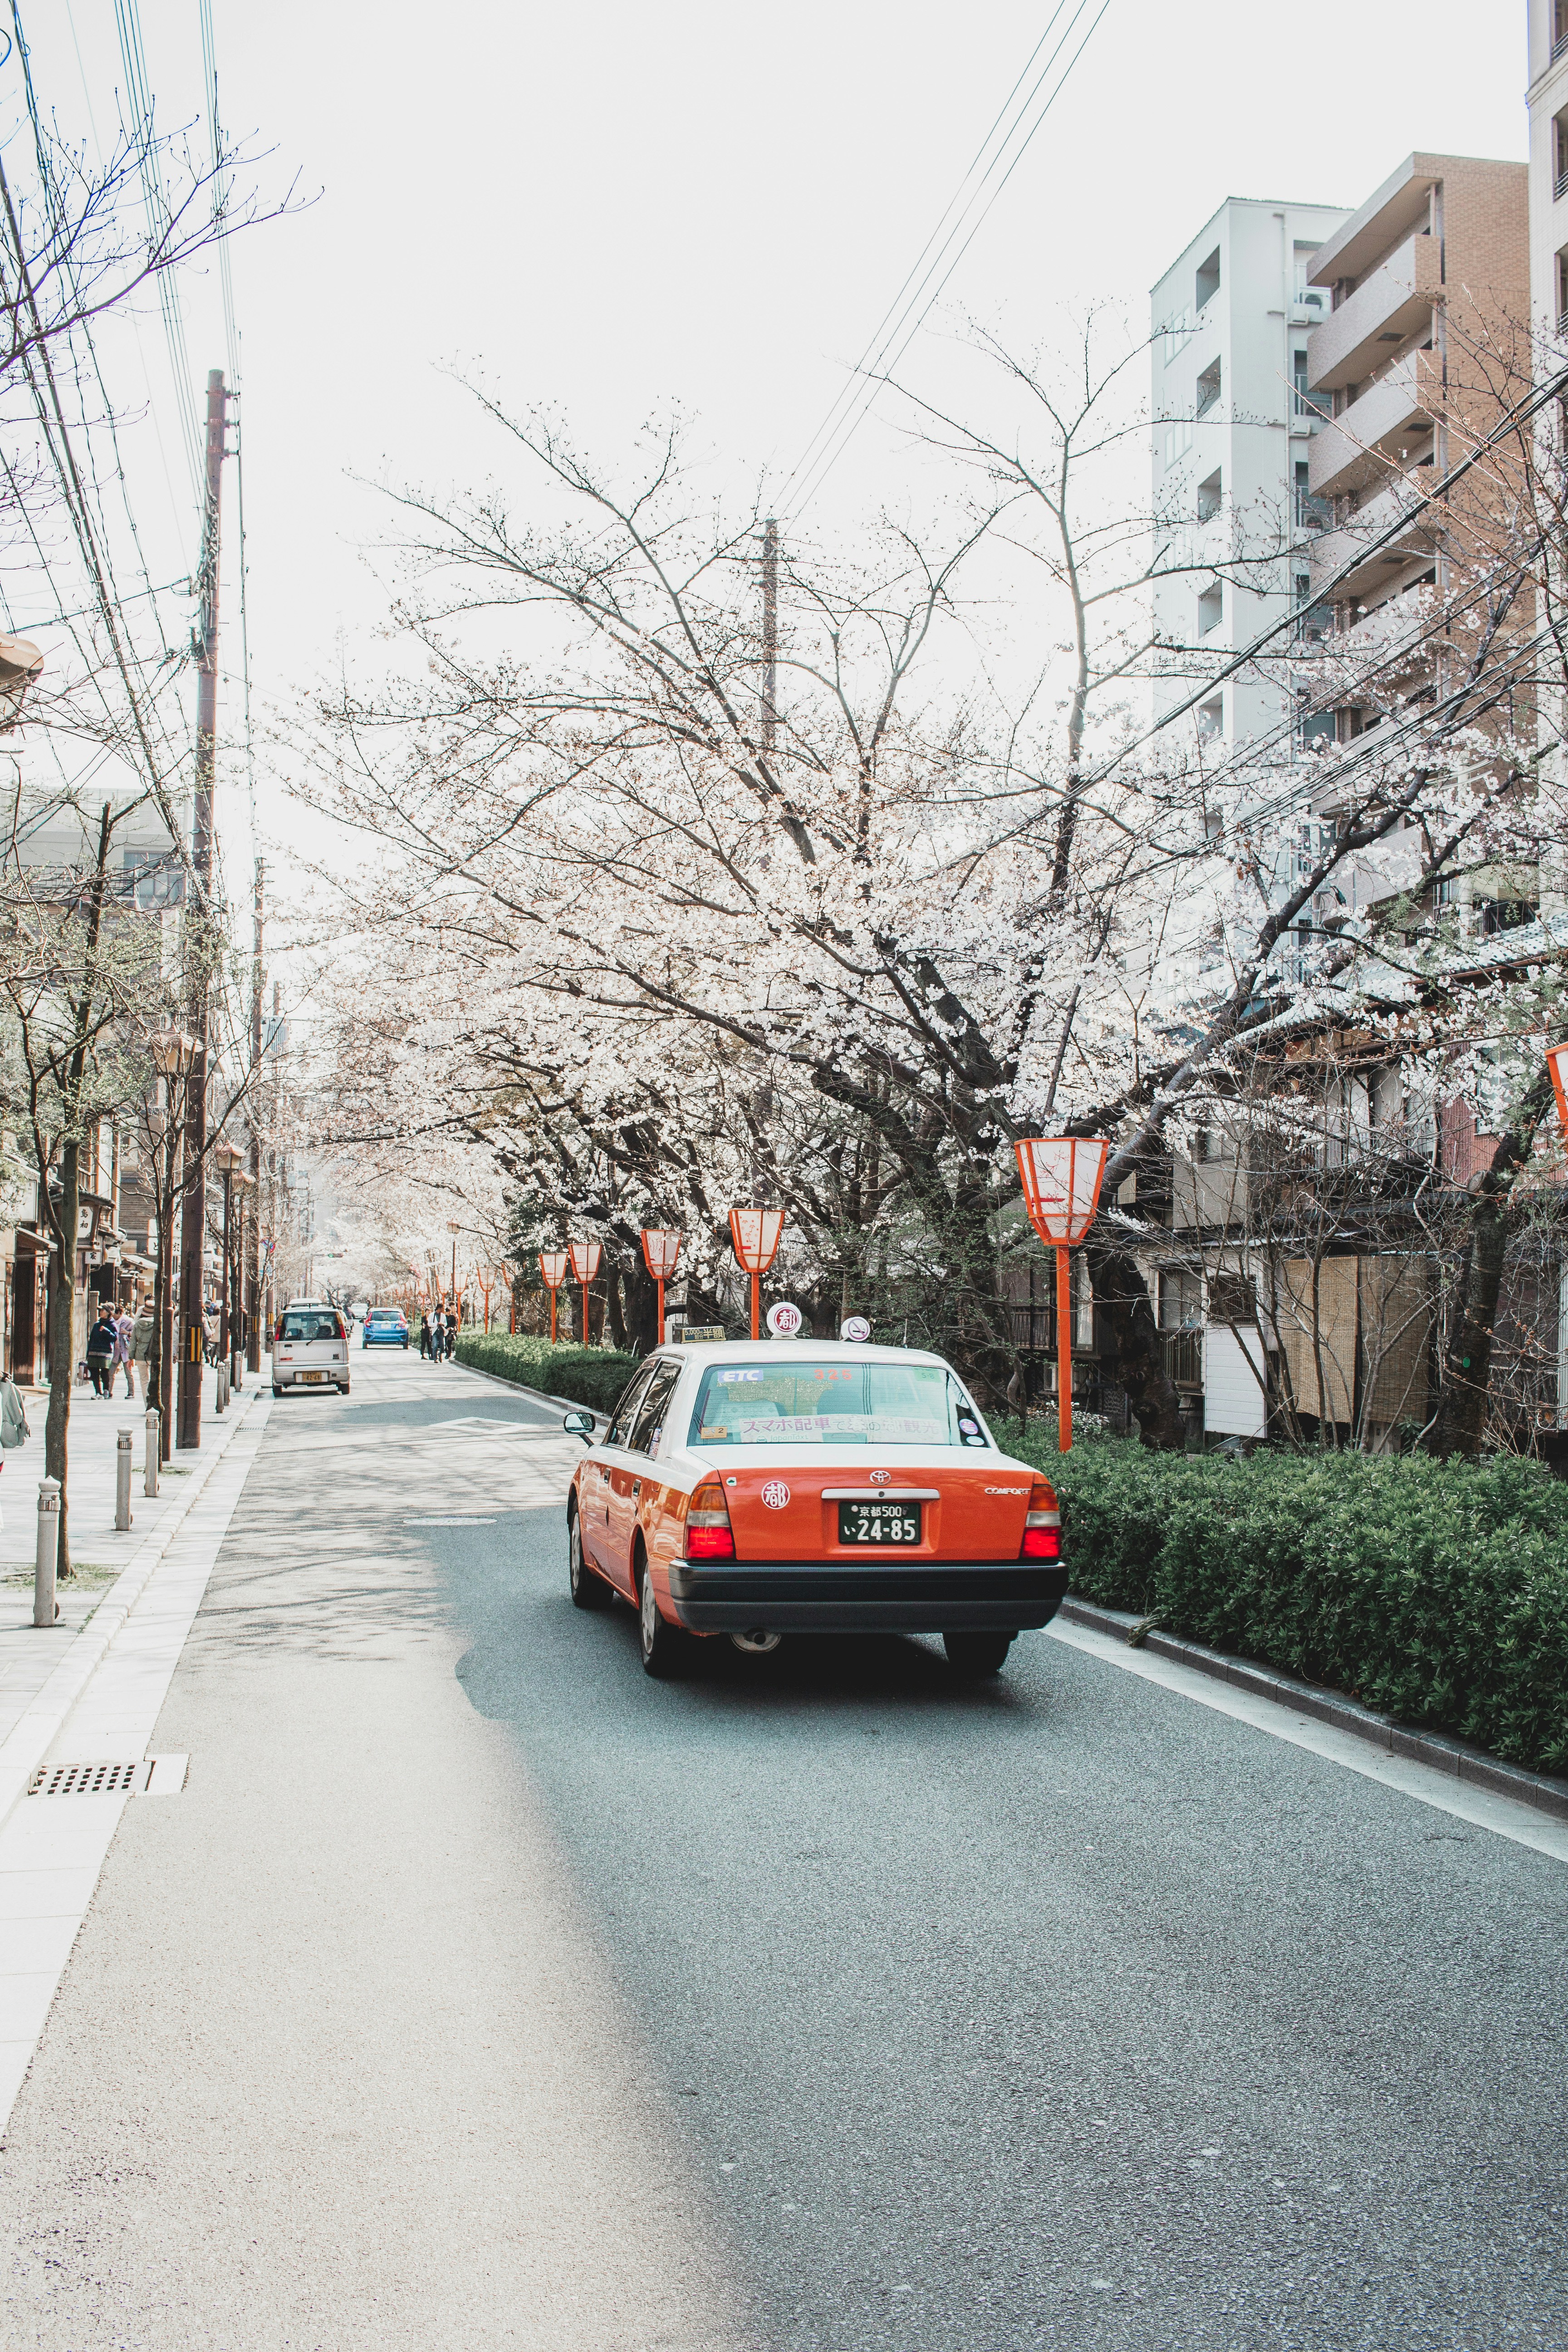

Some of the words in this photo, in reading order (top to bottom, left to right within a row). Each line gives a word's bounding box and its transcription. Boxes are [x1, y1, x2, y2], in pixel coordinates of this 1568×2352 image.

[779, 1310, 797, 1329] 都
[703, 1328, 723, 1339] 半額
[722, 1370, 760, 1382] ETC
[814, 1369, 853, 1380] 325
[764, 1483, 786, 1507] 都
[857, 1519, 916, 1540] 24-85
